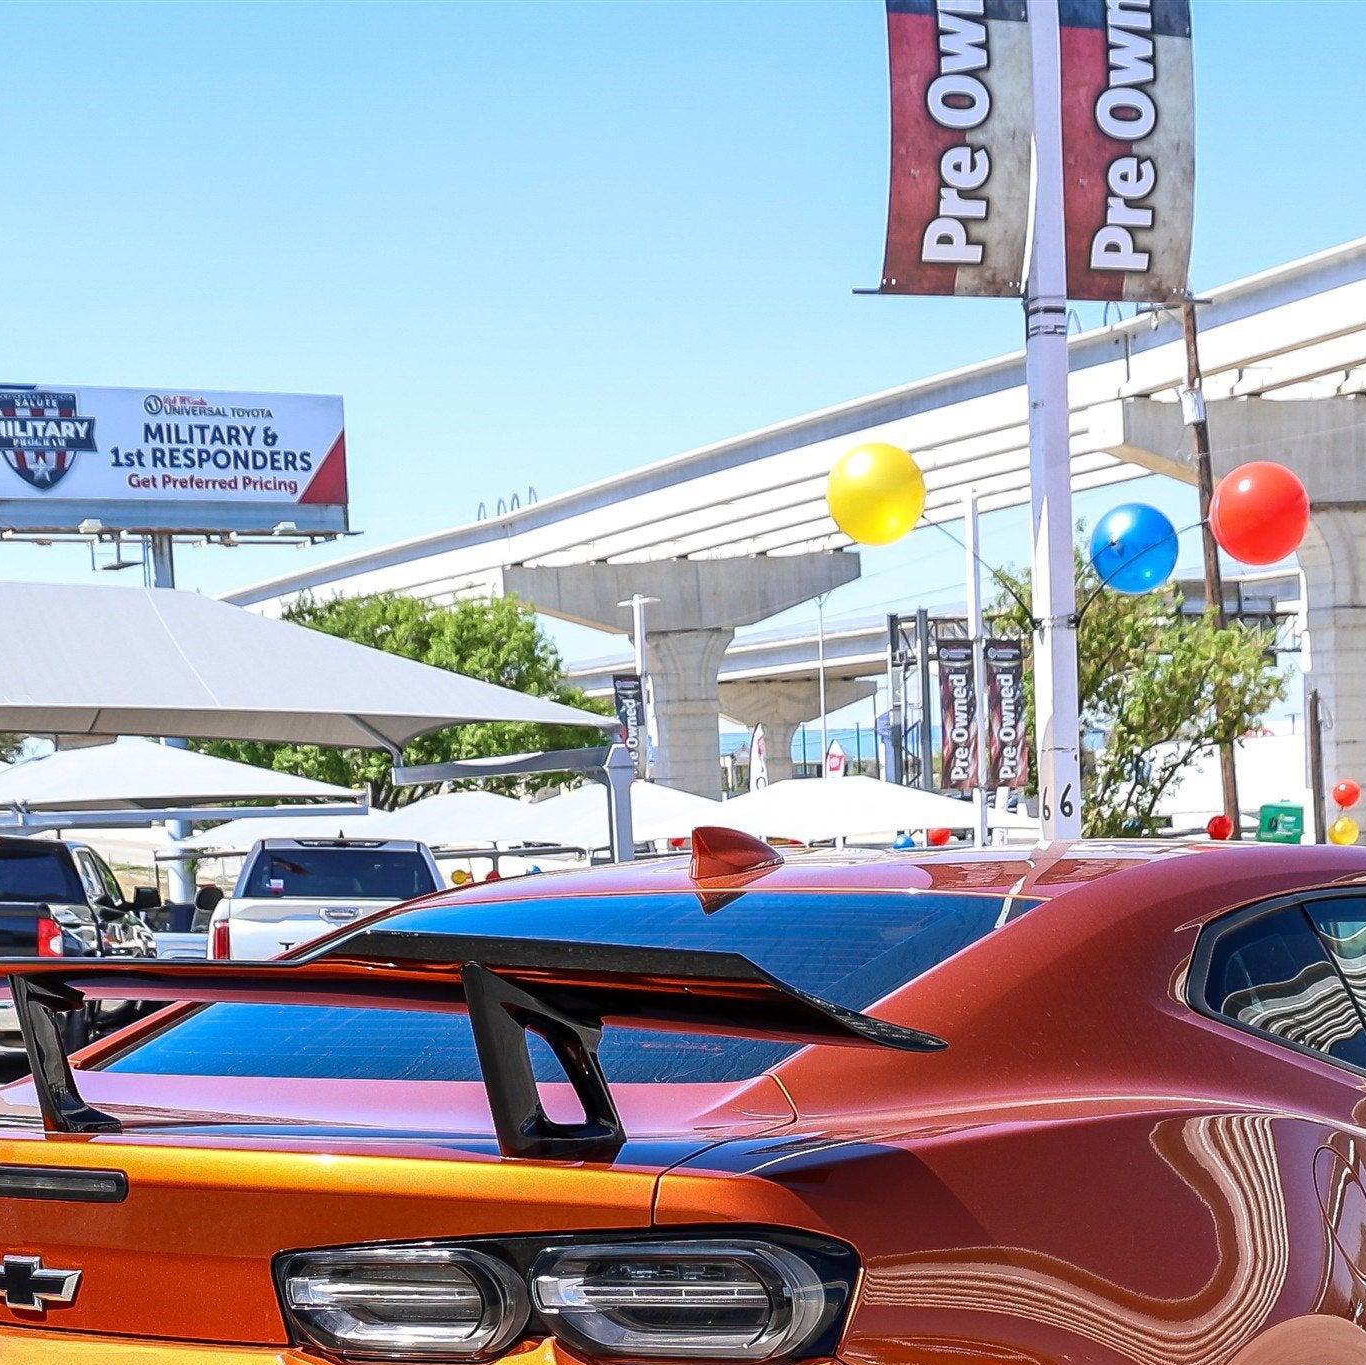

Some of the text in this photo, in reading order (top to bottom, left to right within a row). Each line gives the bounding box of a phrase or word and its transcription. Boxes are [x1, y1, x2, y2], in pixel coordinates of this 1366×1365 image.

[921, 145, 990, 265] Pre
[1090, 156, 1156, 273] Pre
[163, 404, 273, 419] UNIVERSAL TOYOTA
[143, 422, 279, 448] MILITARY &
[110, 446, 313, 472] 1st RESPONDERS
[128, 473, 298, 495] Get Preferred Pricing
[622, 698, 638, 747] Owned
[949, 674, 969, 743] Owned
[997, 674, 1017, 742] Owned
[951, 745, 969, 781] Pre
[999, 745, 1017, 780] Pre
[1060, 783, 1074, 818] 6
